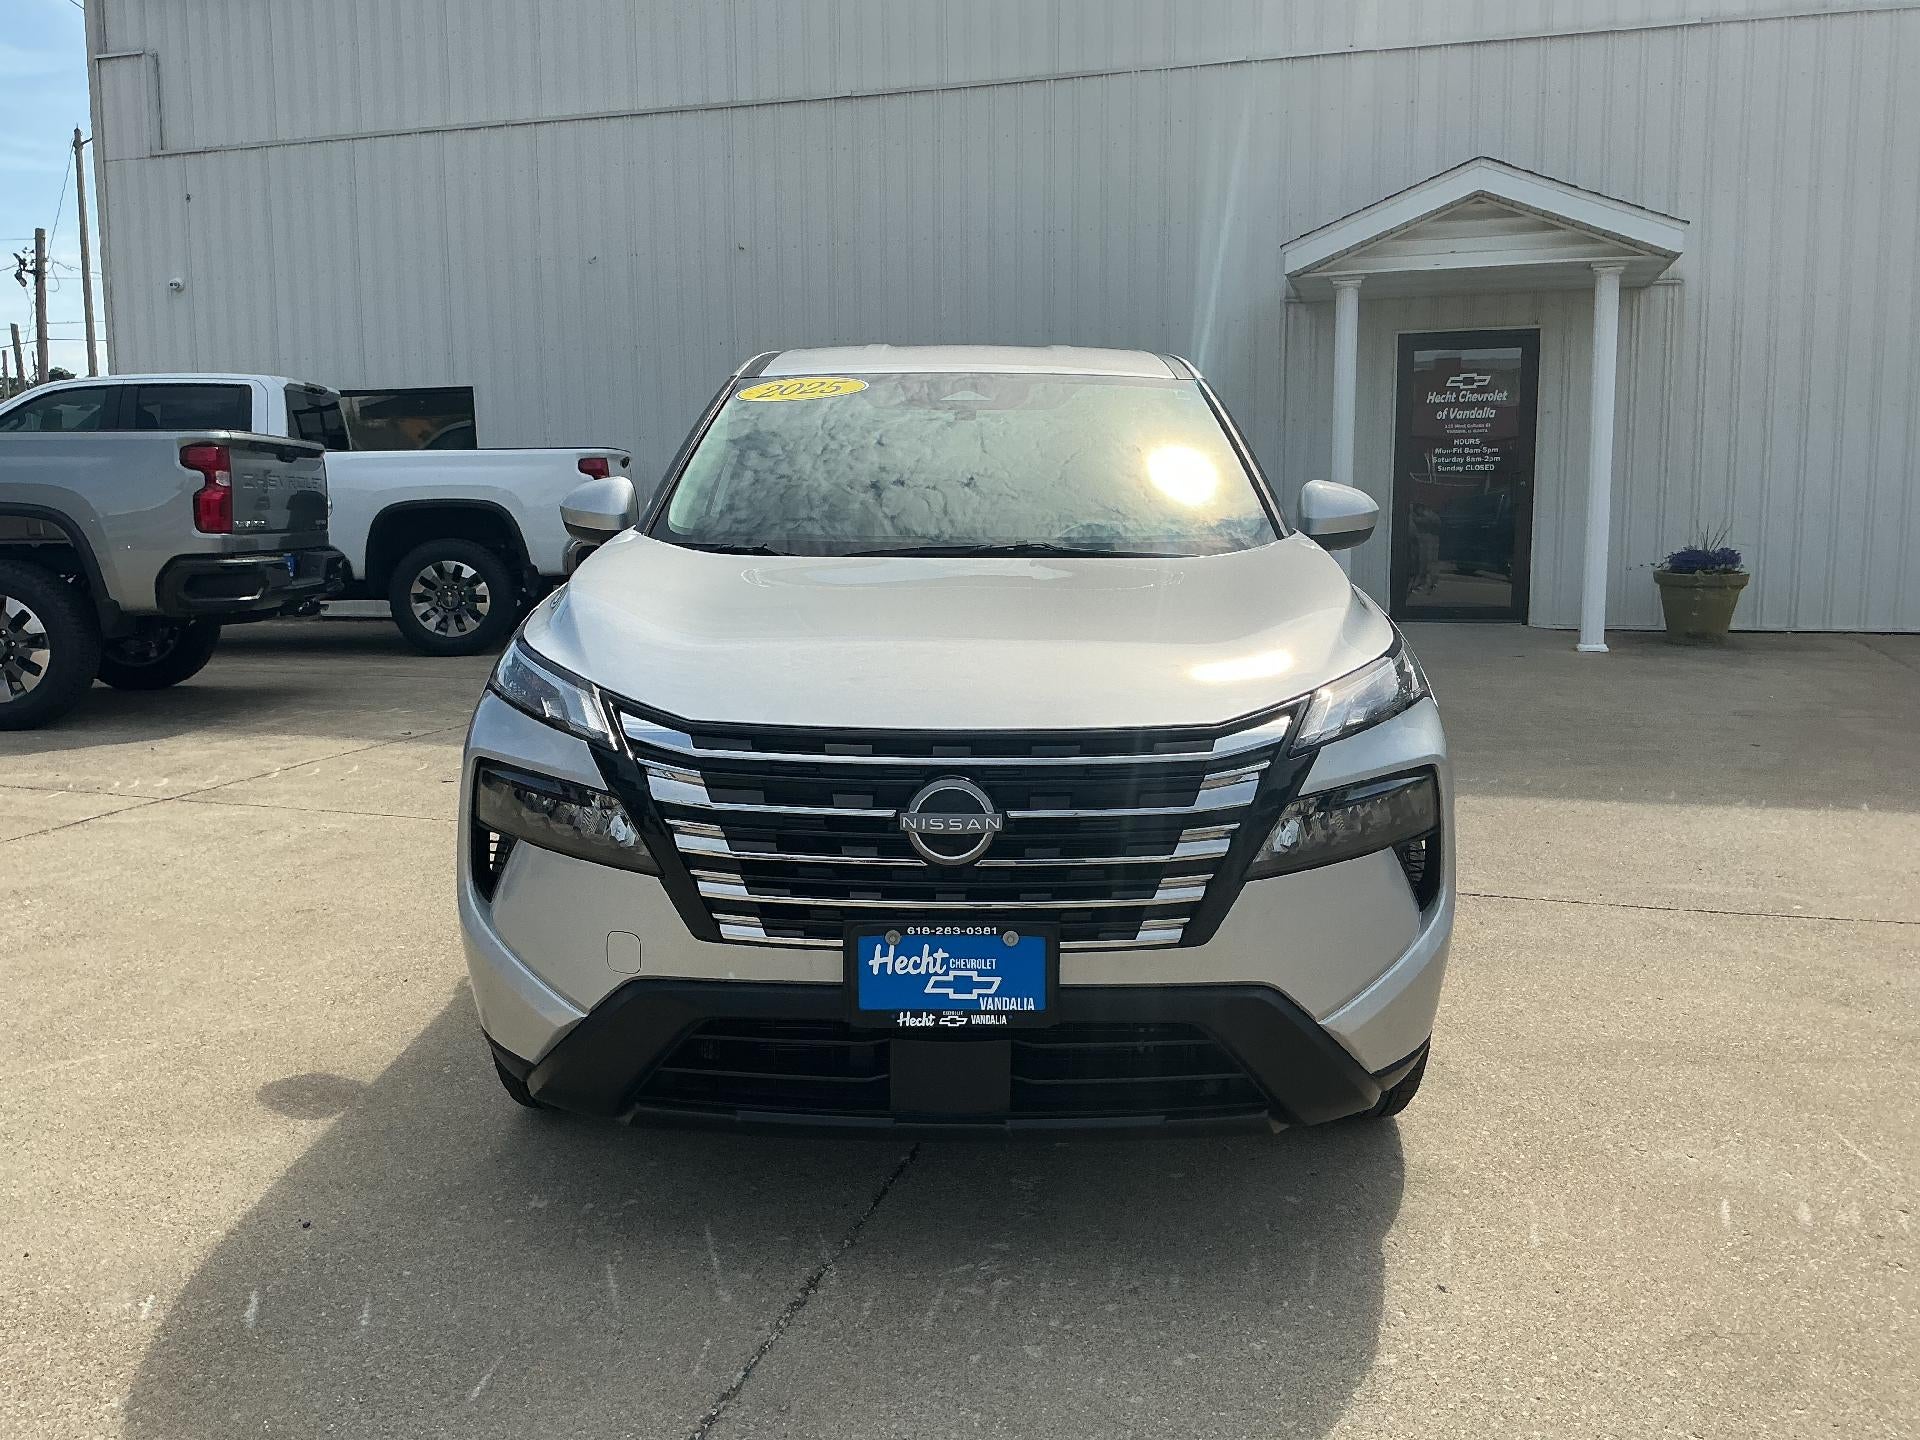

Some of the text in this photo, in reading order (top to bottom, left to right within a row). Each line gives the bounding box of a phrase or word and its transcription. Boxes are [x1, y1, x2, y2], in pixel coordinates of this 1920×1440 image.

[755, 381, 848, 399] 2025
[1426, 389, 1508, 404] Hecht Chevrolet
[1436, 406, 1496, 420] of Vandalia
[1433, 456, 1464, 464] Saturday
[1437, 465, 1464, 473] Sunday
[902, 816, 1000, 831] NISSAN
[907, 926, 998, 935] 618-283-0381
[868, 943, 997, 976] Hecht CHEVROLET
[979, 996, 1035, 1011] VANDALIA
[896, 1010, 936, 1027] Hecht
[970, 1014, 1008, 1025] VANDALIA
